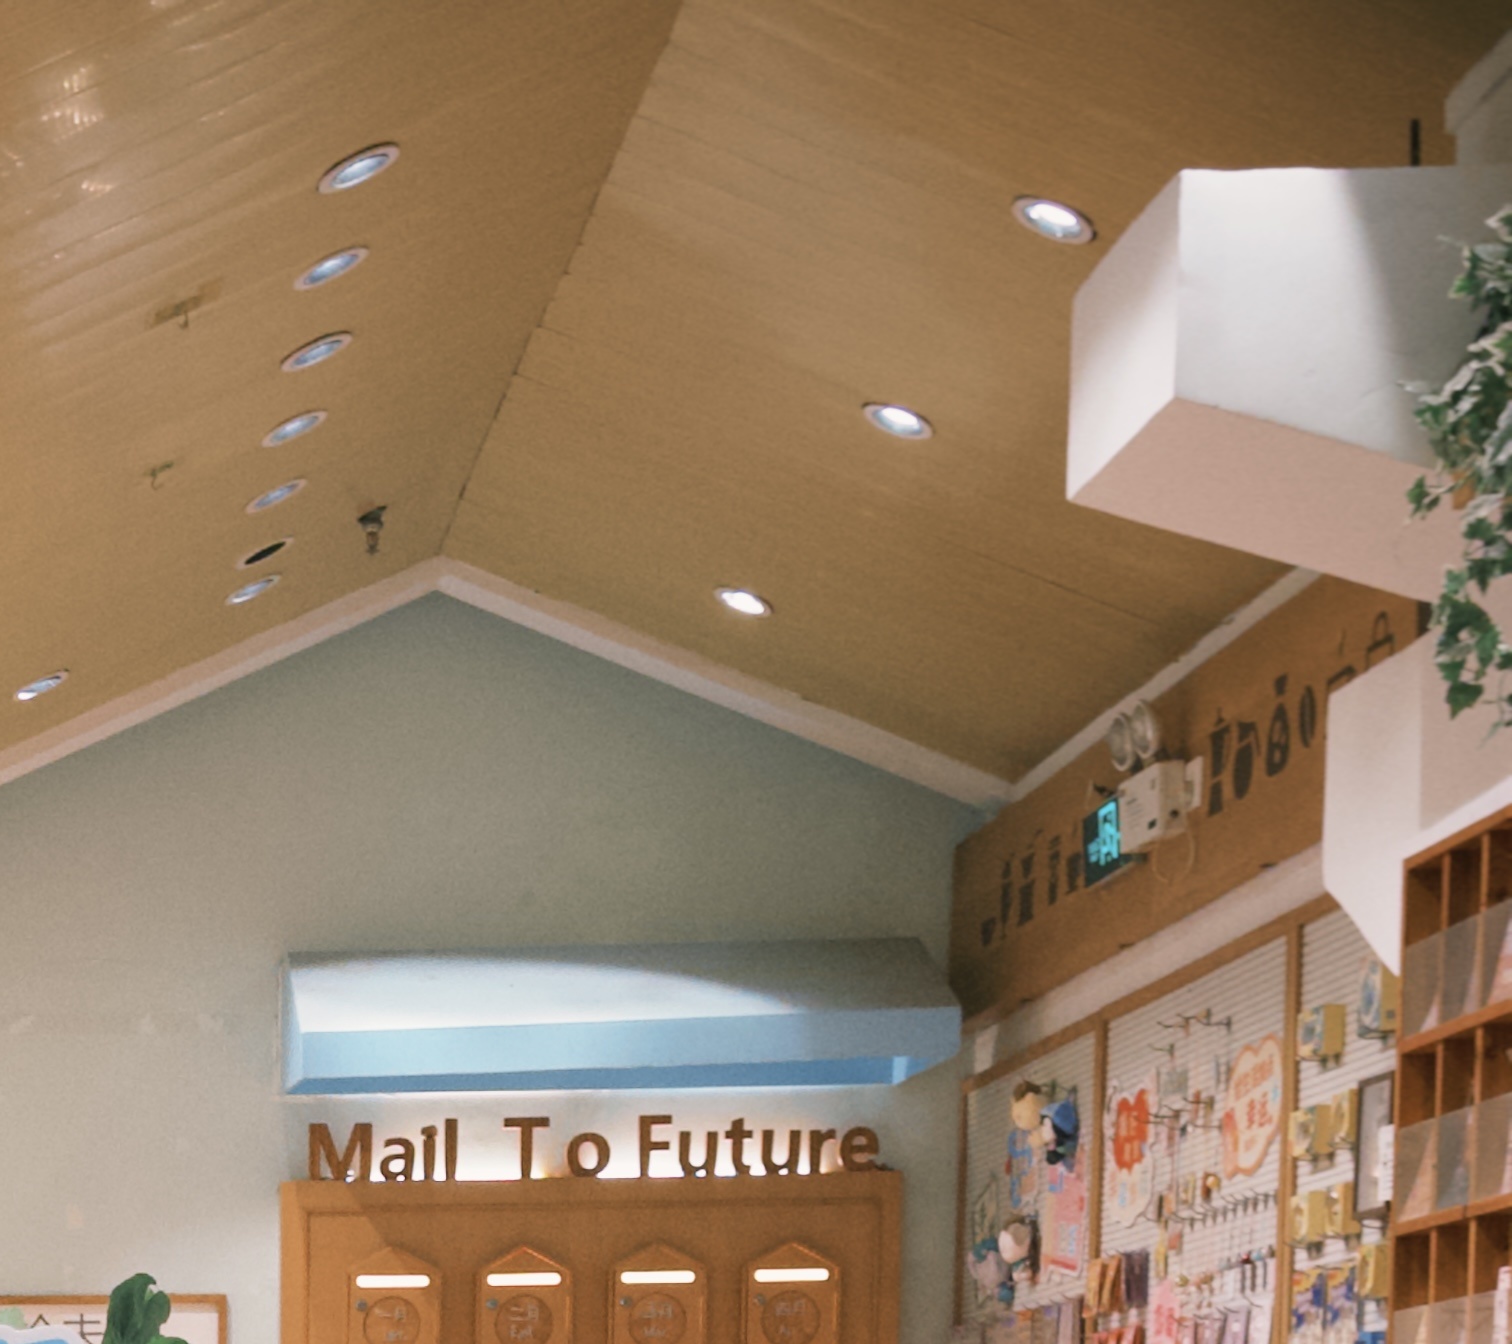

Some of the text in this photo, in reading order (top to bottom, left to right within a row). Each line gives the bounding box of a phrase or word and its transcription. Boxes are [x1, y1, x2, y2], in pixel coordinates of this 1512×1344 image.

[307, 1114, 880, 1180] Mail To Future
